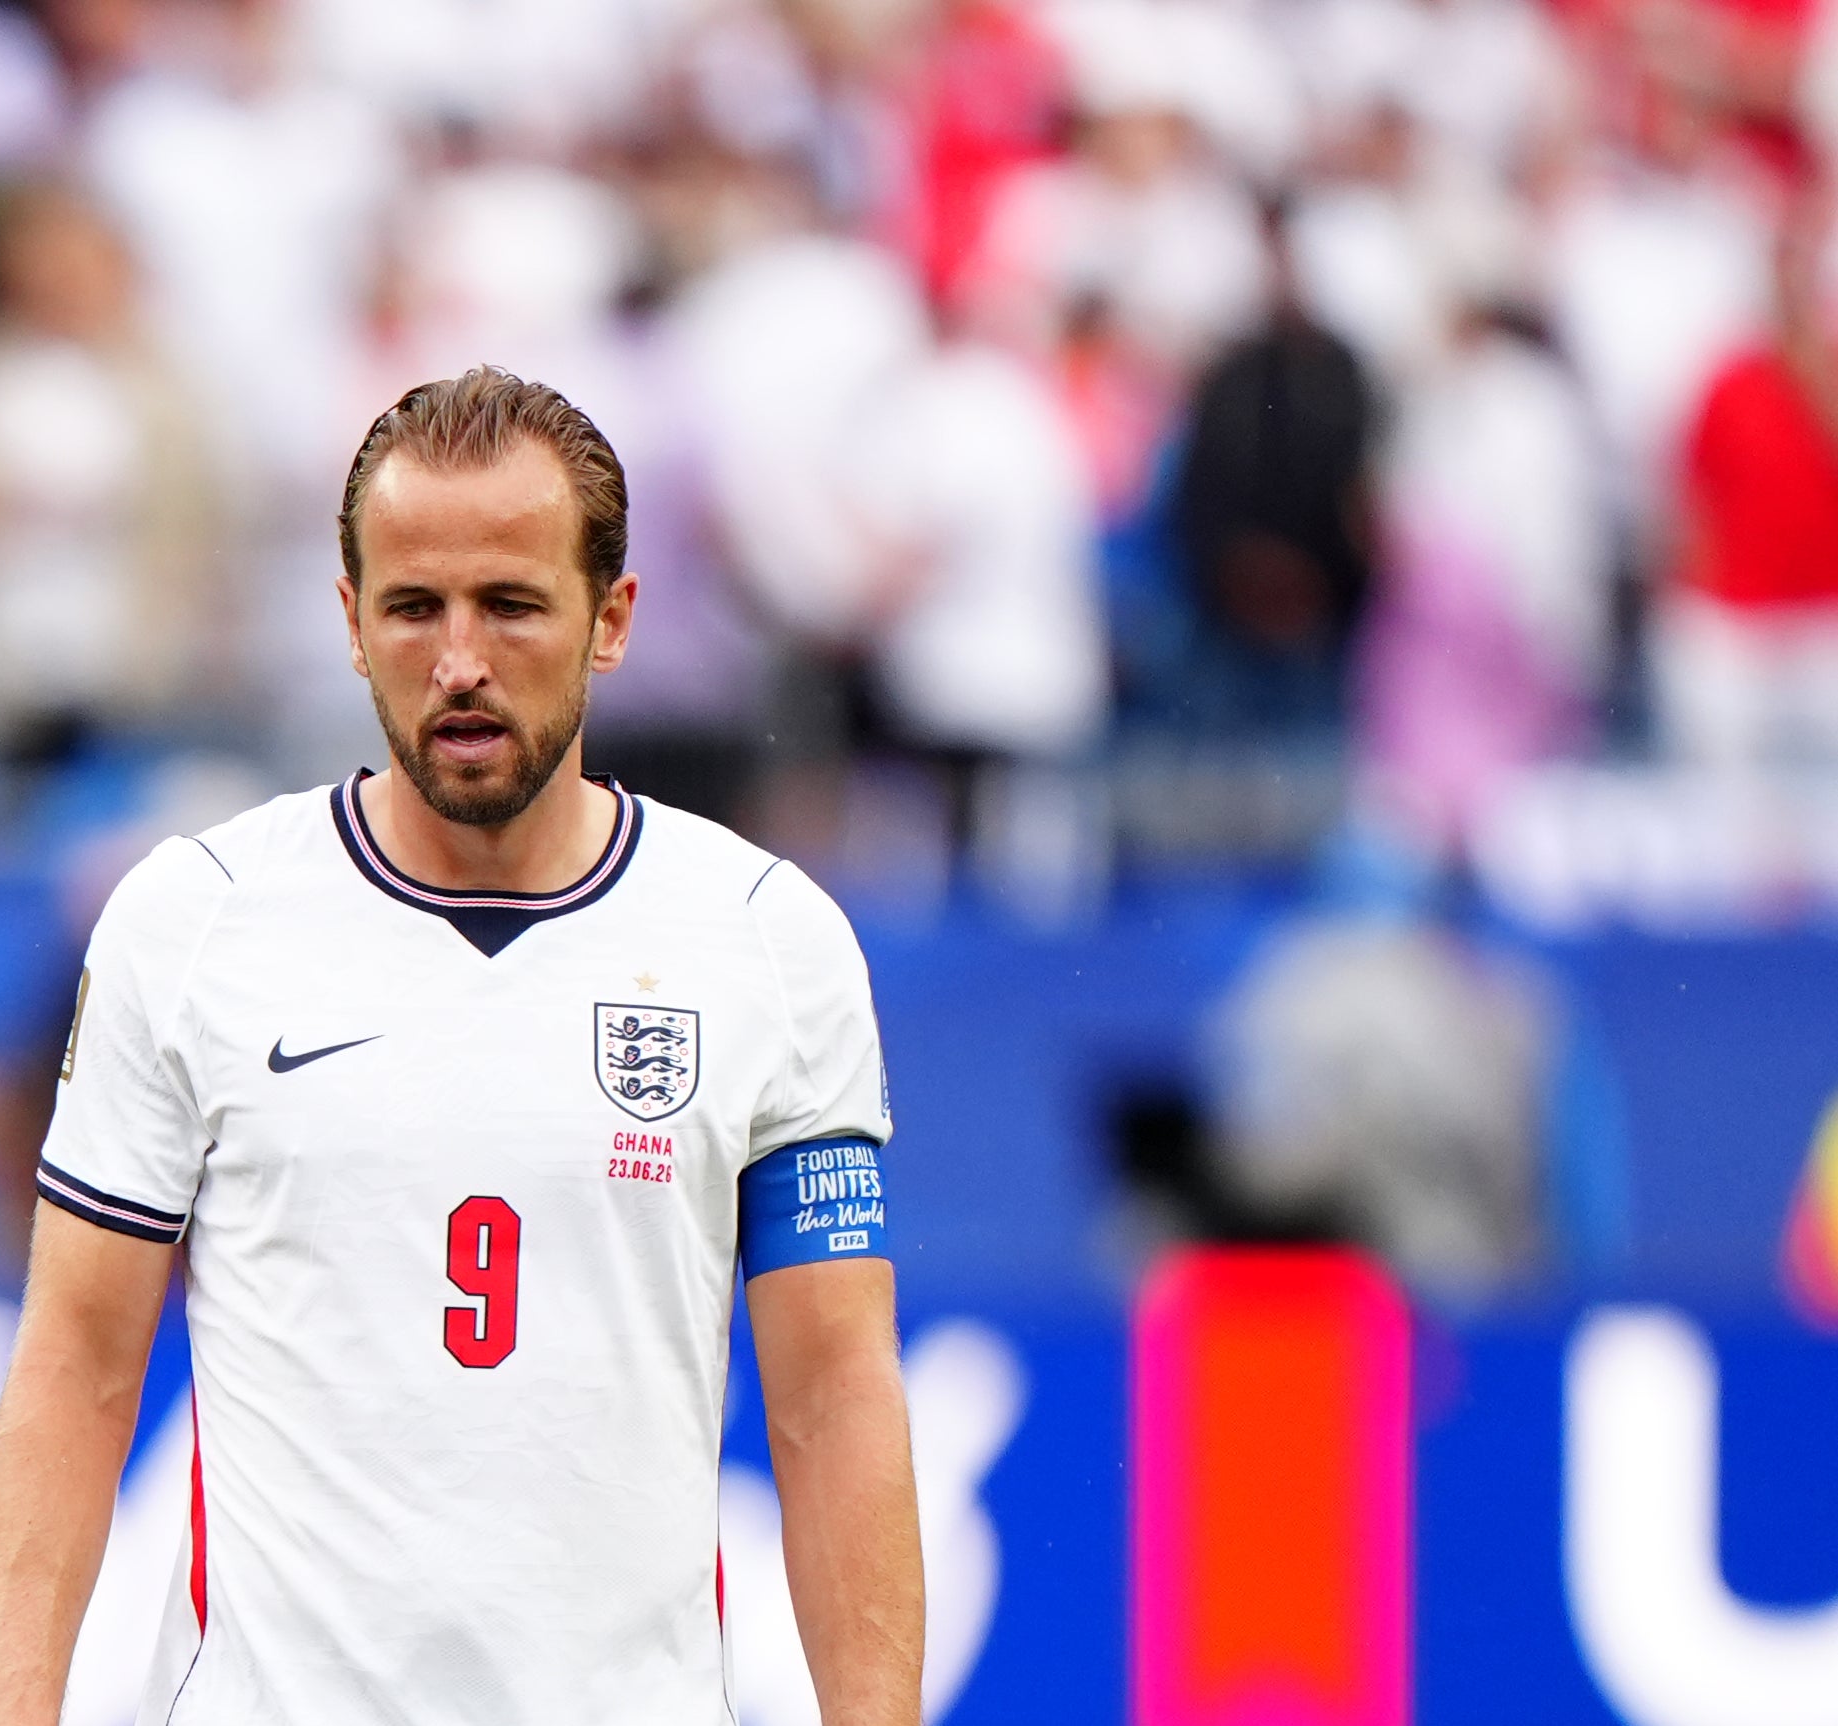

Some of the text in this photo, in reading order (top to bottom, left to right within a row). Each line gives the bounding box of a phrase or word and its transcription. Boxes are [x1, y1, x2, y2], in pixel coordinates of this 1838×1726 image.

[613, 1132, 672, 1157] GHANA
[608, 1158, 672, 1183] 23.06.26
[795, 1146, 877, 1174] FOOTBALL
[798, 1169, 882, 1204] UNITES
[791, 1200, 885, 1234] the World
[833, 1234, 865, 1248] FIFA
[443, 1195, 521, 1369] 9
